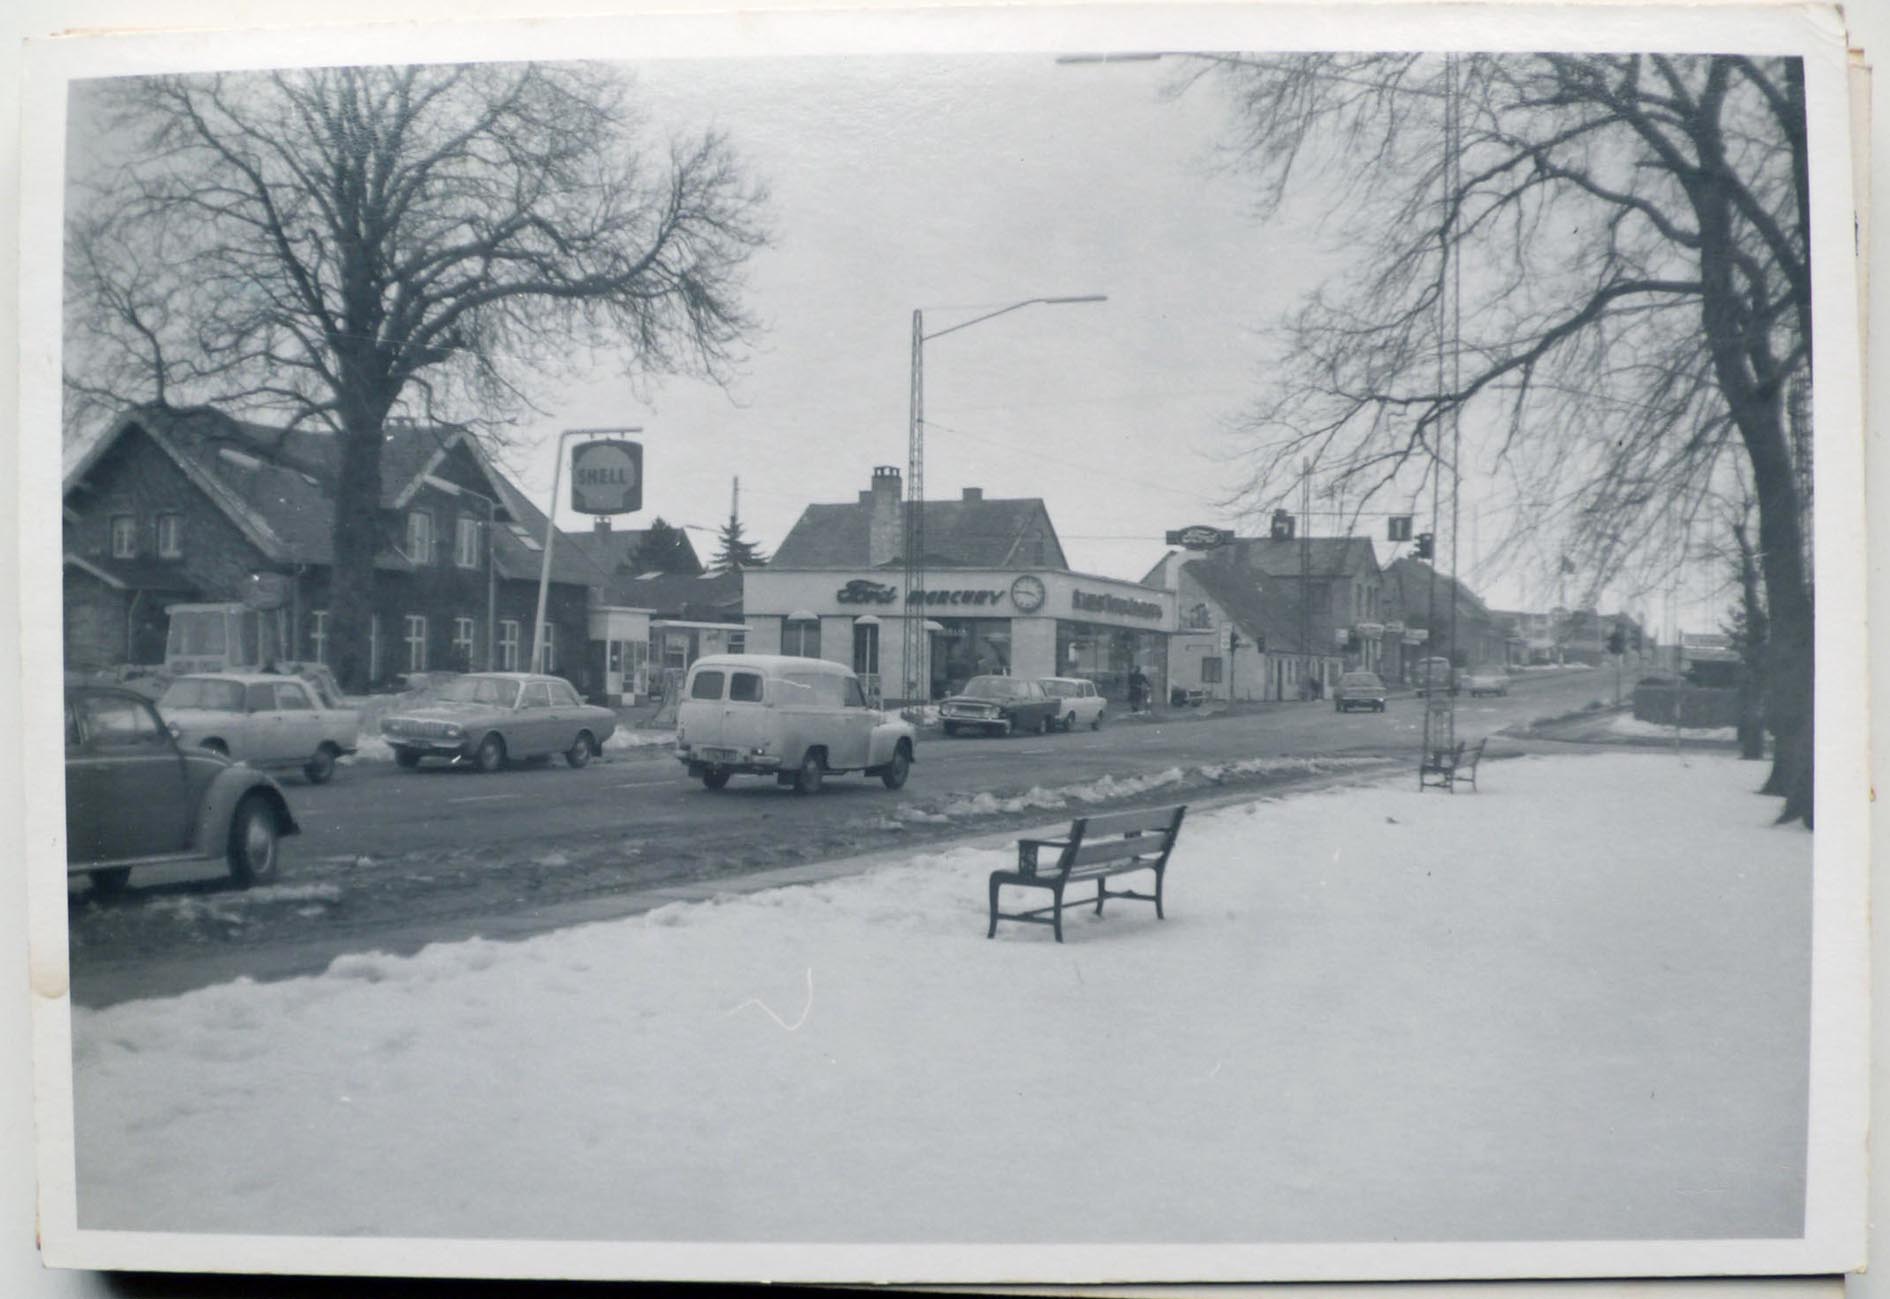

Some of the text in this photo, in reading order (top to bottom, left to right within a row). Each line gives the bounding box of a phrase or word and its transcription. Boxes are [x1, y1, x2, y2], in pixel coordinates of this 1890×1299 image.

[577, 468, 627, 486] SHELL
[836, 579, 1006, 606] Ford MERCURY
